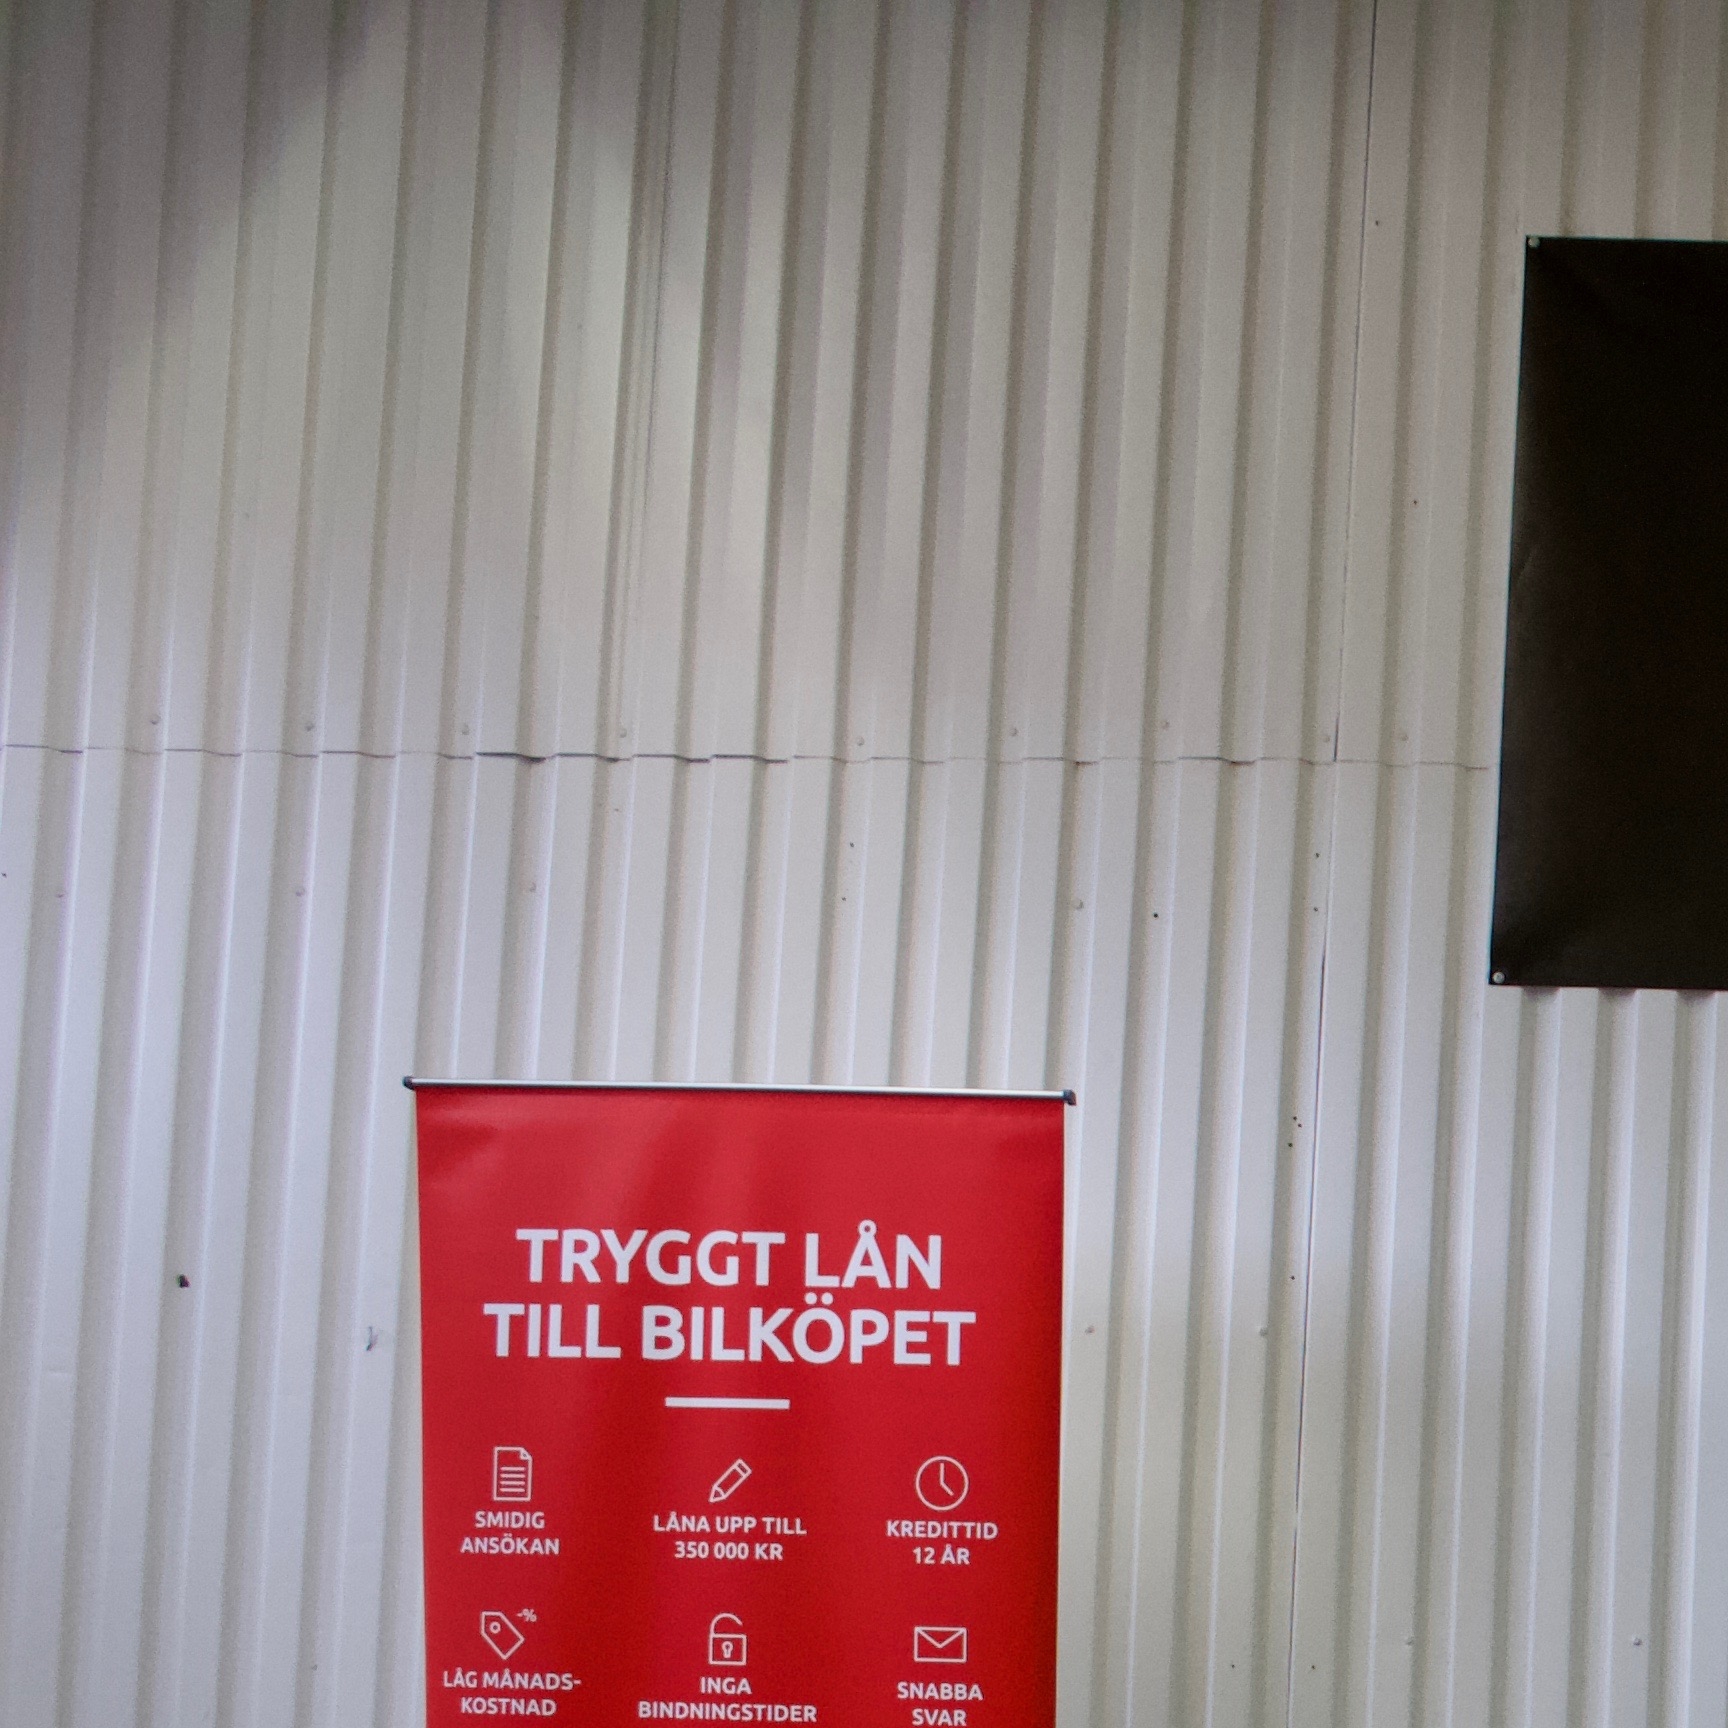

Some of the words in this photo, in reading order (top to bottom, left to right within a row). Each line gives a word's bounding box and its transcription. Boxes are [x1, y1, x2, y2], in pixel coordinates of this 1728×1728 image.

[515, 1228, 786, 1287] TRYGGT
[804, 1219, 942, 1290] LÅN
[482, 1302, 622, 1359] TILL
[641, 1291, 977, 1366] BILKÖPET
[475, 1510, 545, 1530] SMIDIG
[653, 1510, 711, 1533] LÅNA
[715, 1515, 758, 1534] UPP
[761, 1516, 808, 1535] TILL
[886, 1519, 998, 1540] KREDITTID
[459, 1532, 560, 1555] ANSÖKAN
[674, 1540, 710, 1559] 350
[712, 1541, 750, 1560] 000
[754, 1542, 784, 1561] KR
[912, 1546, 936, 1565] 12
[939, 1543, 970, 1565] ÅR
[443, 1667, 478, 1689] LÅG
[481, 1667, 581, 1691] MÅNADS-
[700, 1676, 752, 1695] INGA
[897, 1681, 984, 1701] SNABBA
[460, 1696, 557, 1717] KOSTNAD
[637, 1700, 817, 1723] BINDNINGSTIDER
[911, 1707, 967, 1727] SVAR
